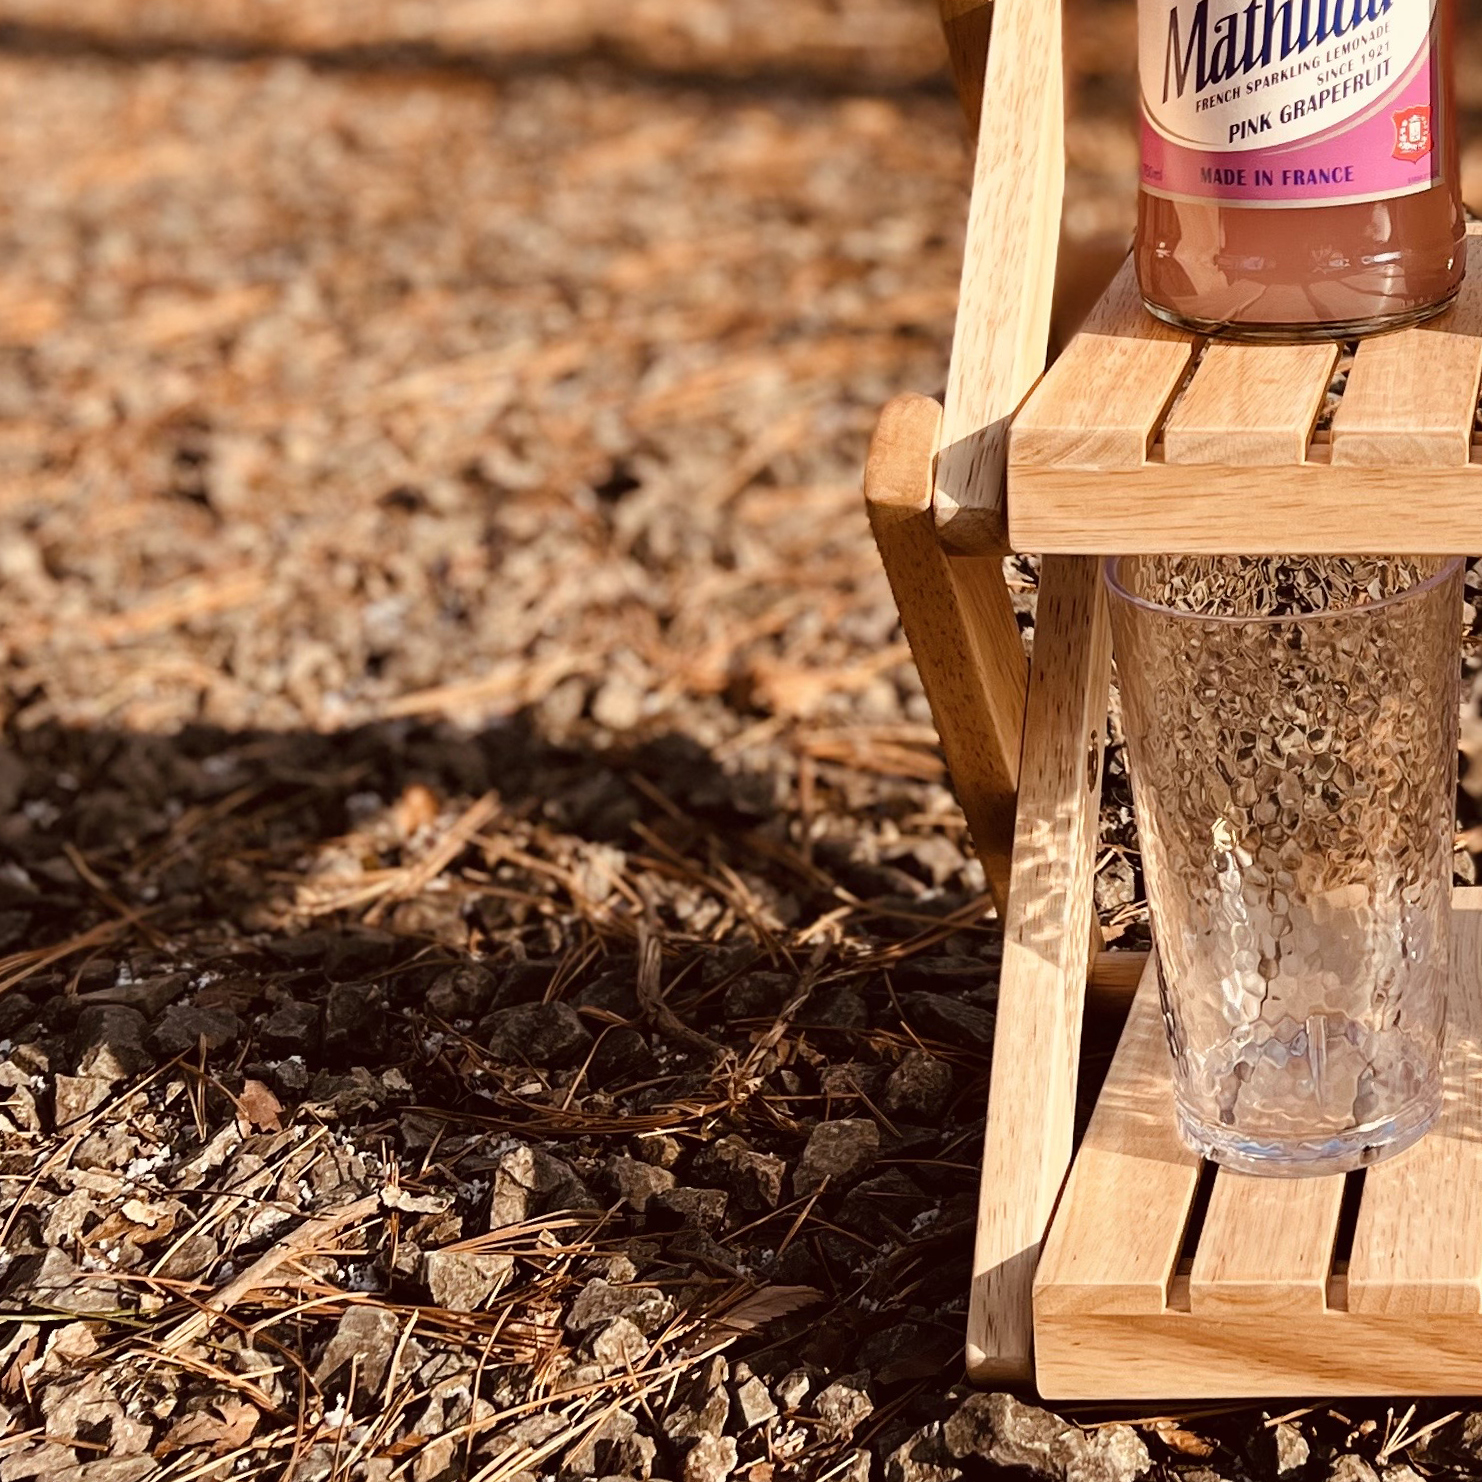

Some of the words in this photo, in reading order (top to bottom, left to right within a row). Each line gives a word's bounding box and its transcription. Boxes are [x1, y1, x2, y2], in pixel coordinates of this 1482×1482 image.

[1195, 84, 1241, 113] FRENCH
[1246, 56, 1321, 94] SPARKLING
[1326, 21, 1392, 64] LEMONADE
[1316, 59, 1355, 86] SINCE
[1361, 41, 1391, 66] 1921
[1229, 111, 1273, 144] PINK
[1279, 57, 1393, 125] GRAPEFRUIT
[1201, 167, 1247, 186] MADE
[1255, 167, 1273, 186] IN
[1282, 165, 1355, 186] FRANCE
